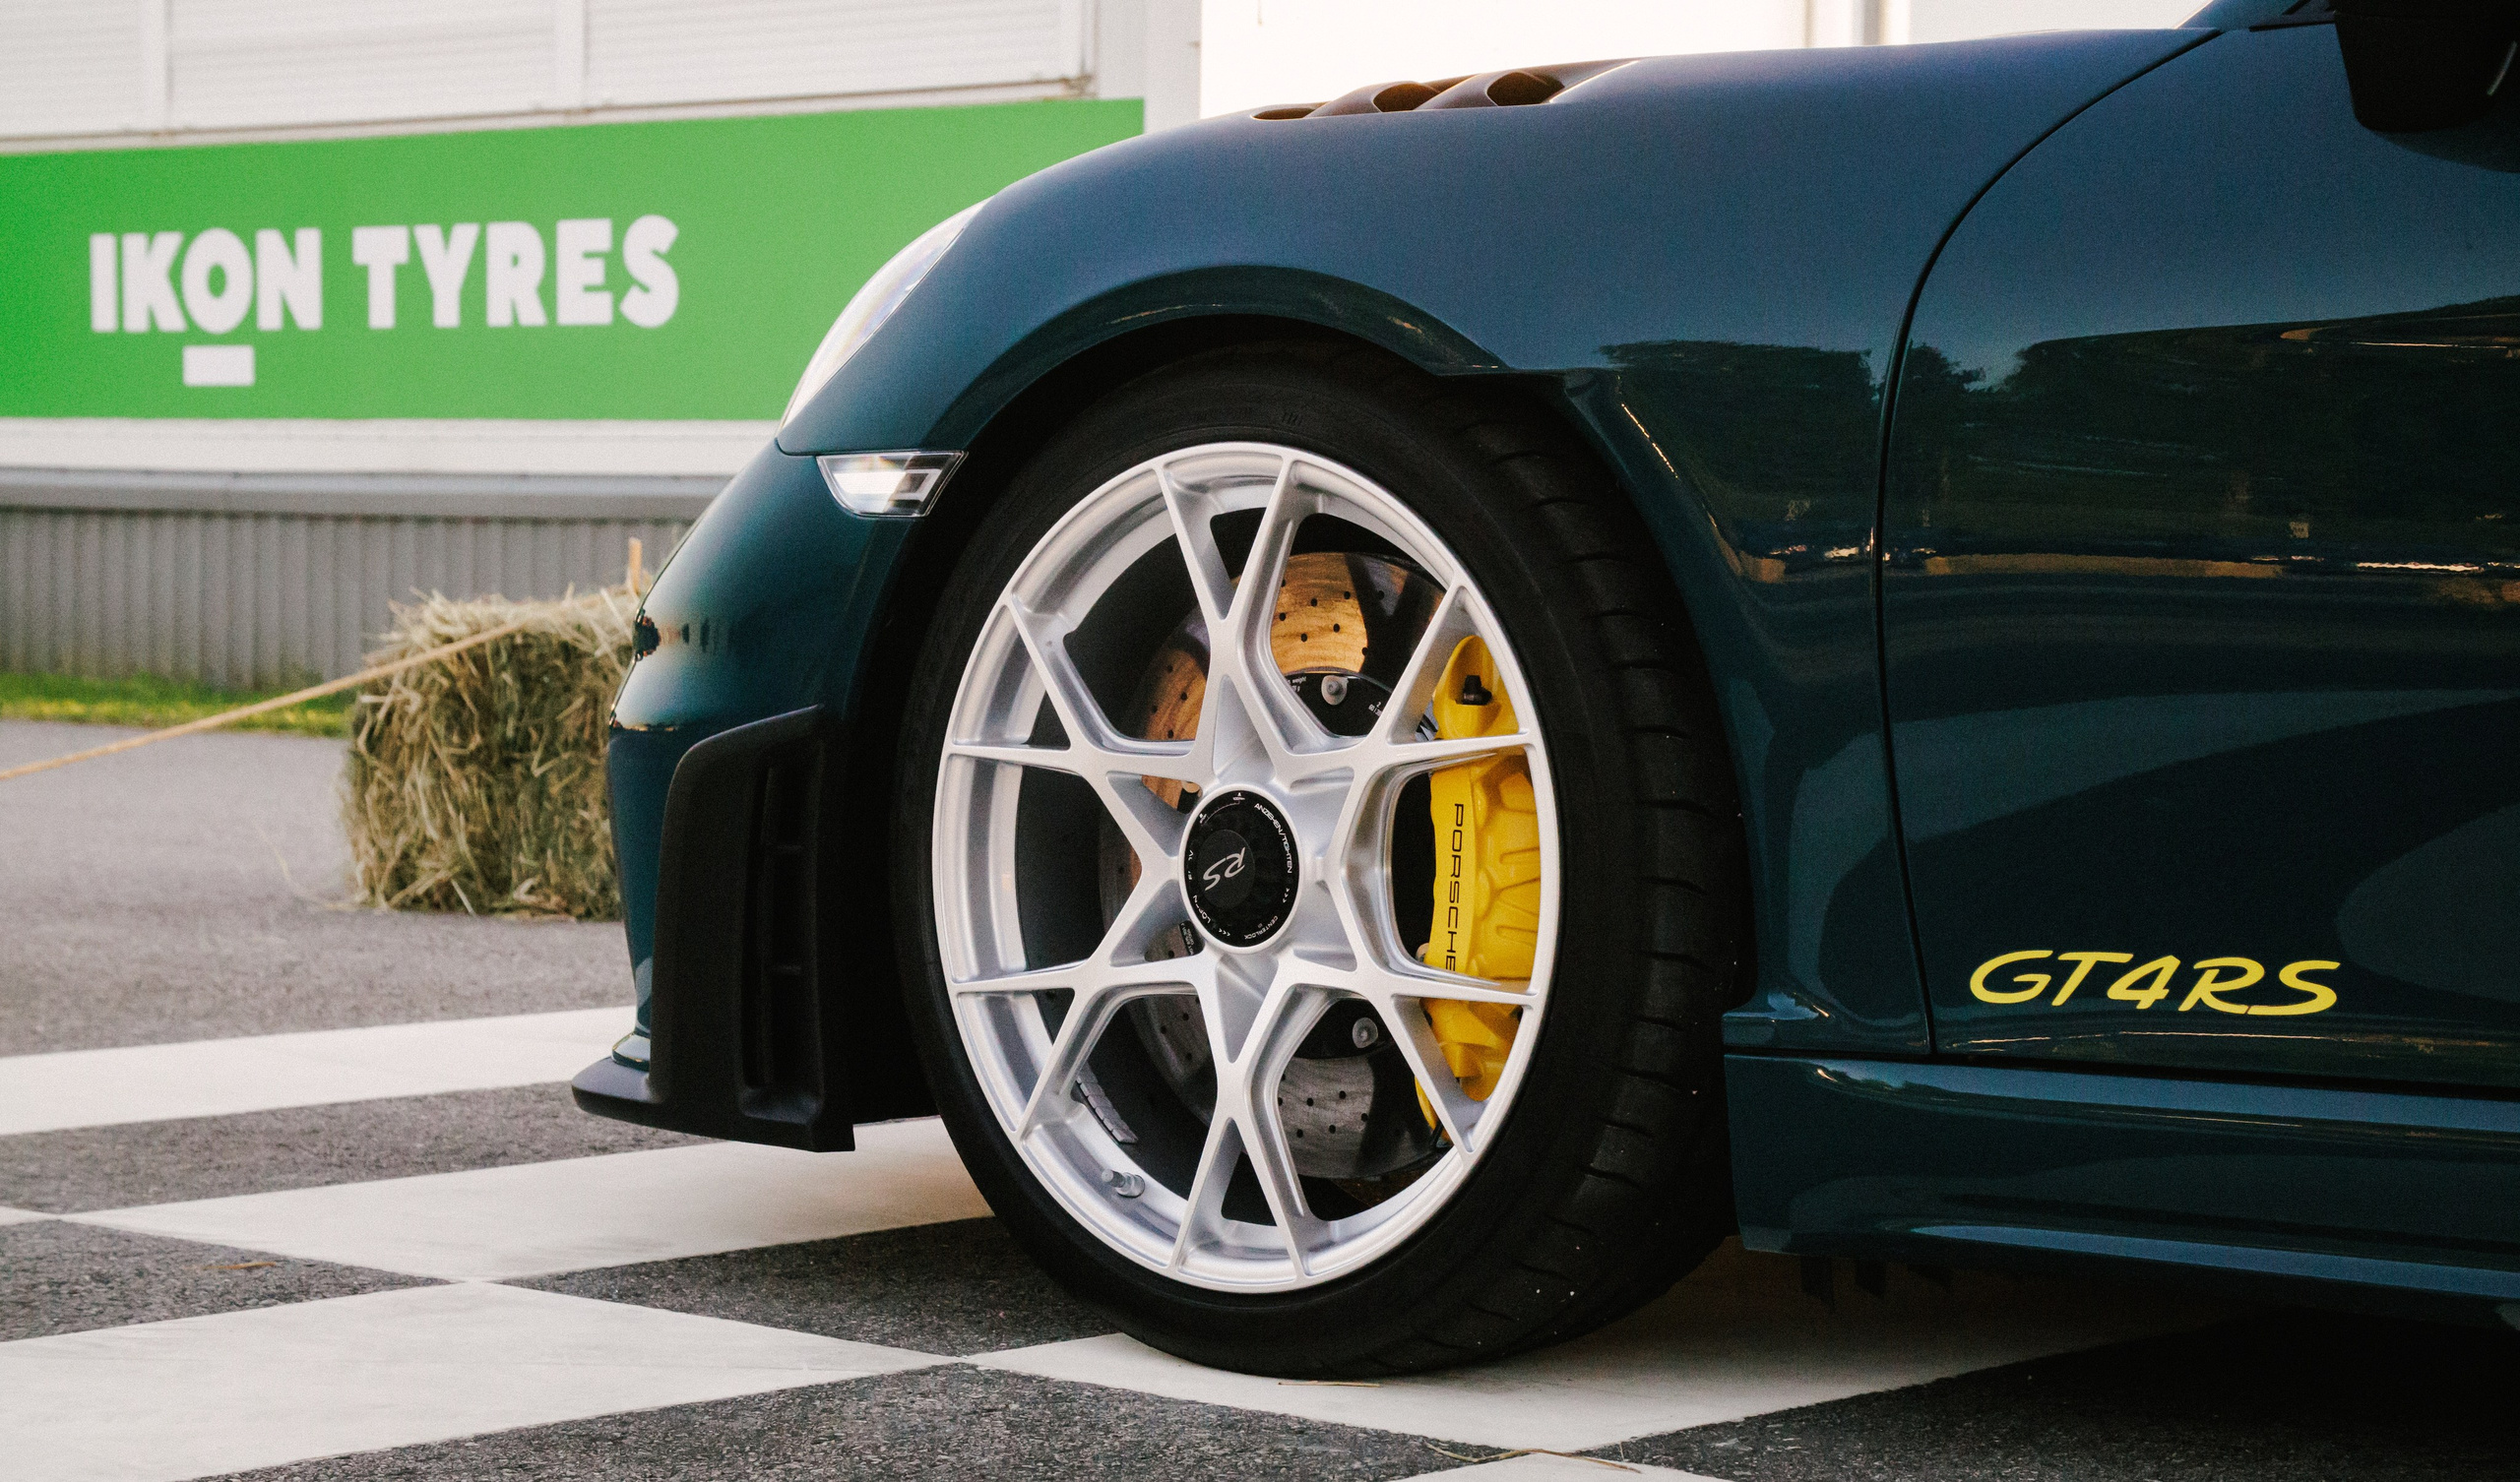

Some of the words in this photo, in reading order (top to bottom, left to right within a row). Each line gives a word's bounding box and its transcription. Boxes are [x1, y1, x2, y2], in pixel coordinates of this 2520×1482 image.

[90, 226, 323, 336] IKON
[351, 214, 680, 330] TYRES
[1445, 803, 1465, 972] PORSCHE
